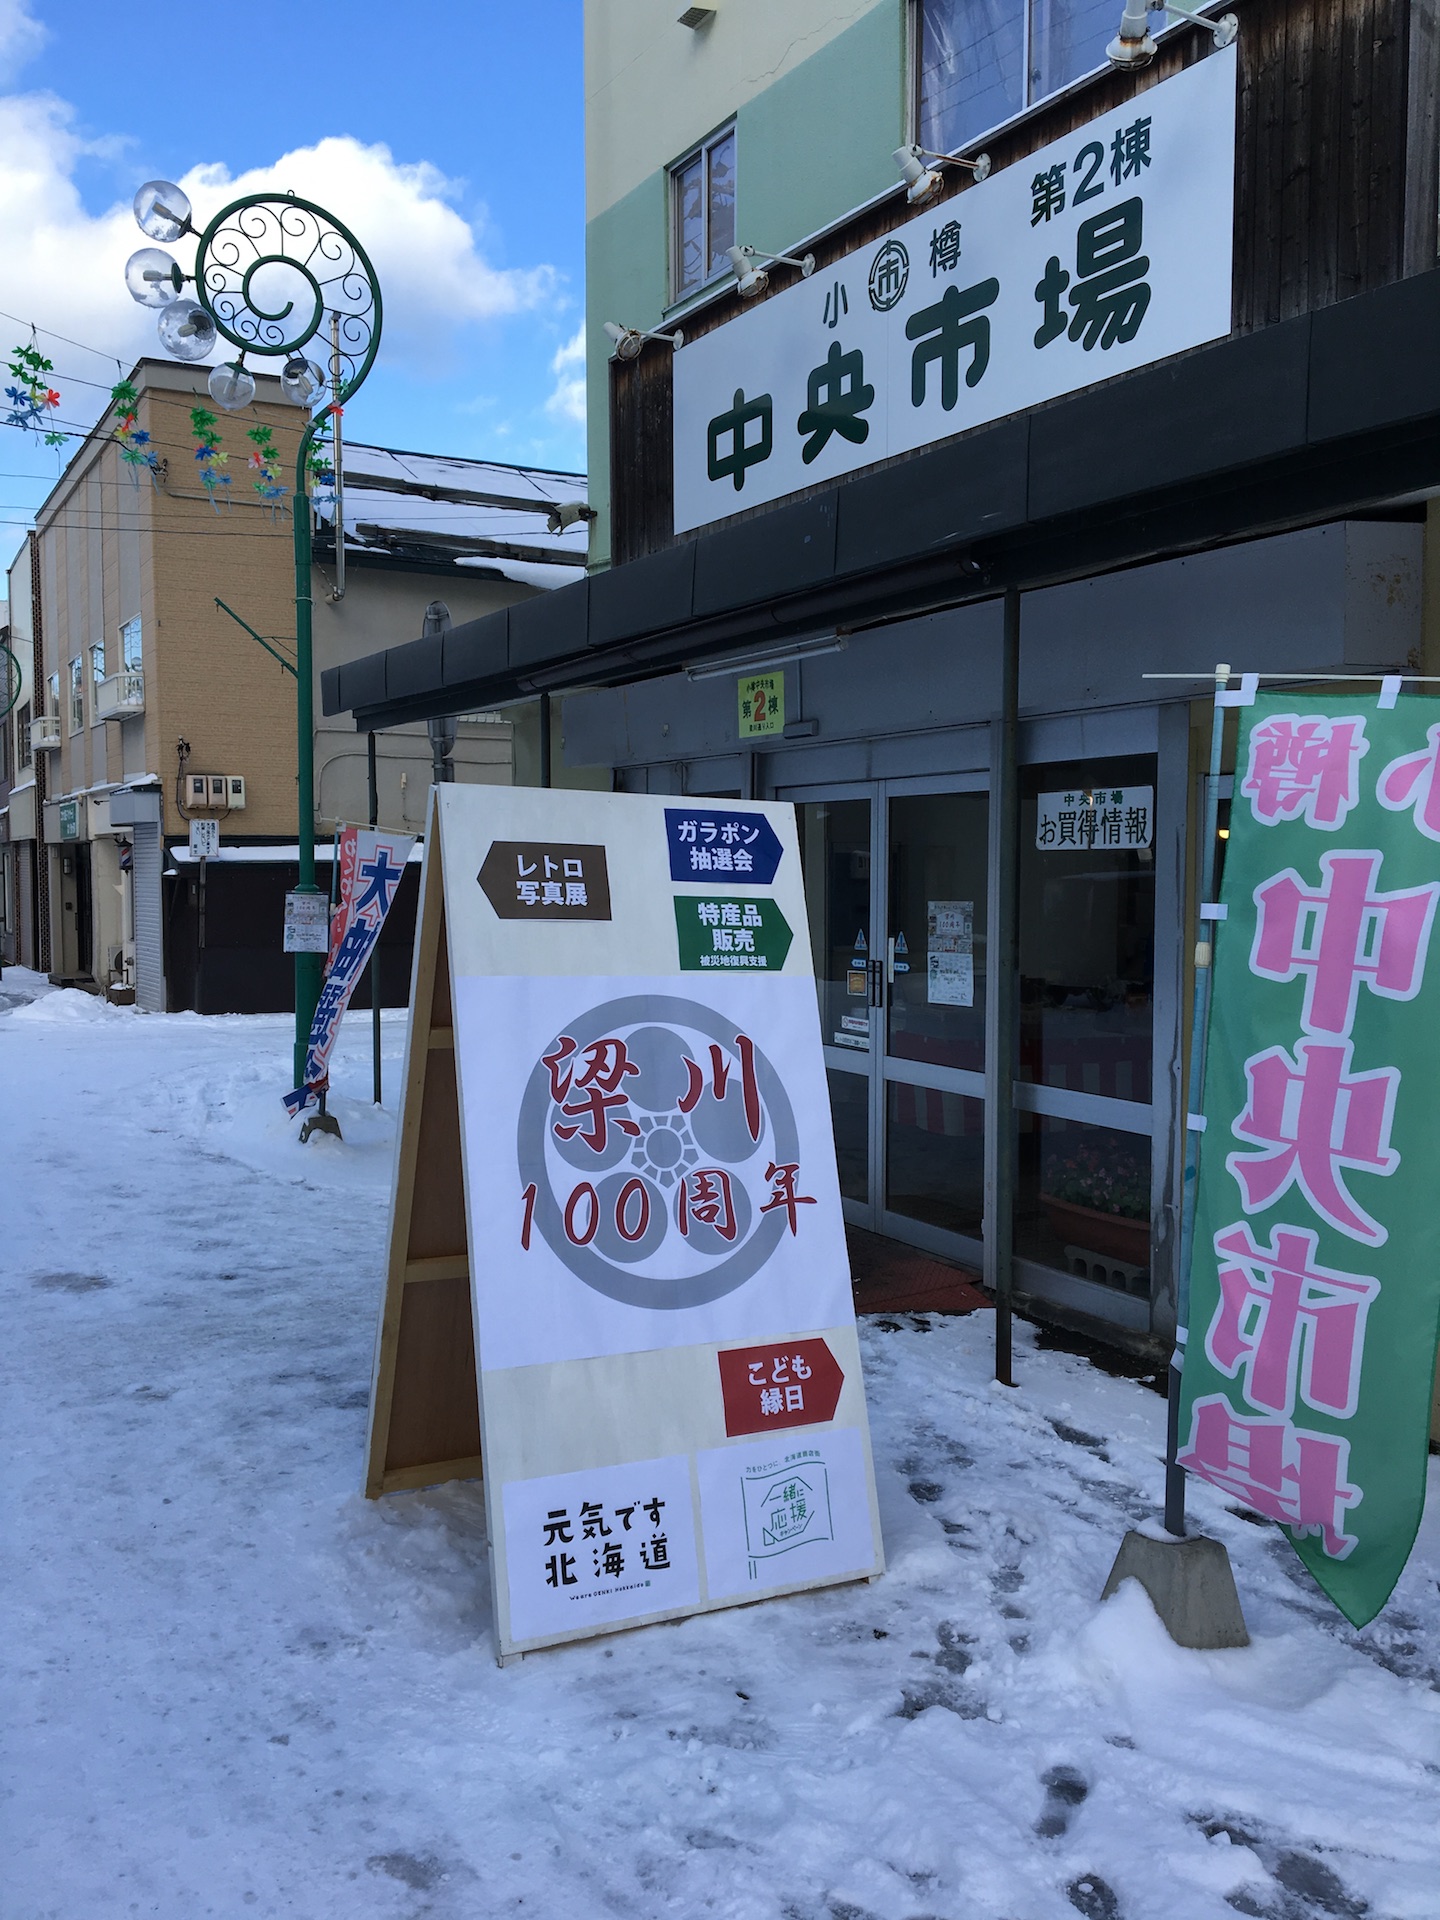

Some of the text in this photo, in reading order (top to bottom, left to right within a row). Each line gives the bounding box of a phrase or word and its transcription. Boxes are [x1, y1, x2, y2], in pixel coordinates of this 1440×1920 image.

[1030, 115, 1152, 228] 第2棟
[707, 196, 1151, 491] 中央市場
[742, 690, 779, 722] 第2棟
[1064, 790, 1124, 807] 中央市場
[677, 820, 760, 844] ガラポン
[1039, 807, 1148, 846] お買得情報
[516, 854, 583, 879] レトロ
[690, 846, 754, 873] 抽選会
[516, 880, 588, 907] 写真展
[698, 902, 763, 927] 特産品
[712, 928, 755, 952] 販売
[700, 955, 767, 967] 被災地復興支援
[541, 1034, 760, 1153] 梁川
[520, 1161, 818, 1251] 100周年
[748, 1355, 812, 1386] こども
[760, 1386, 805, 1417] 縁日
[769, 1483, 804, 1502] 一緒に
[543, 1497, 665, 1546] 元気です
[770, 1498, 807, 1532] 応援
[545, 1532, 671, 1588] 北海道
